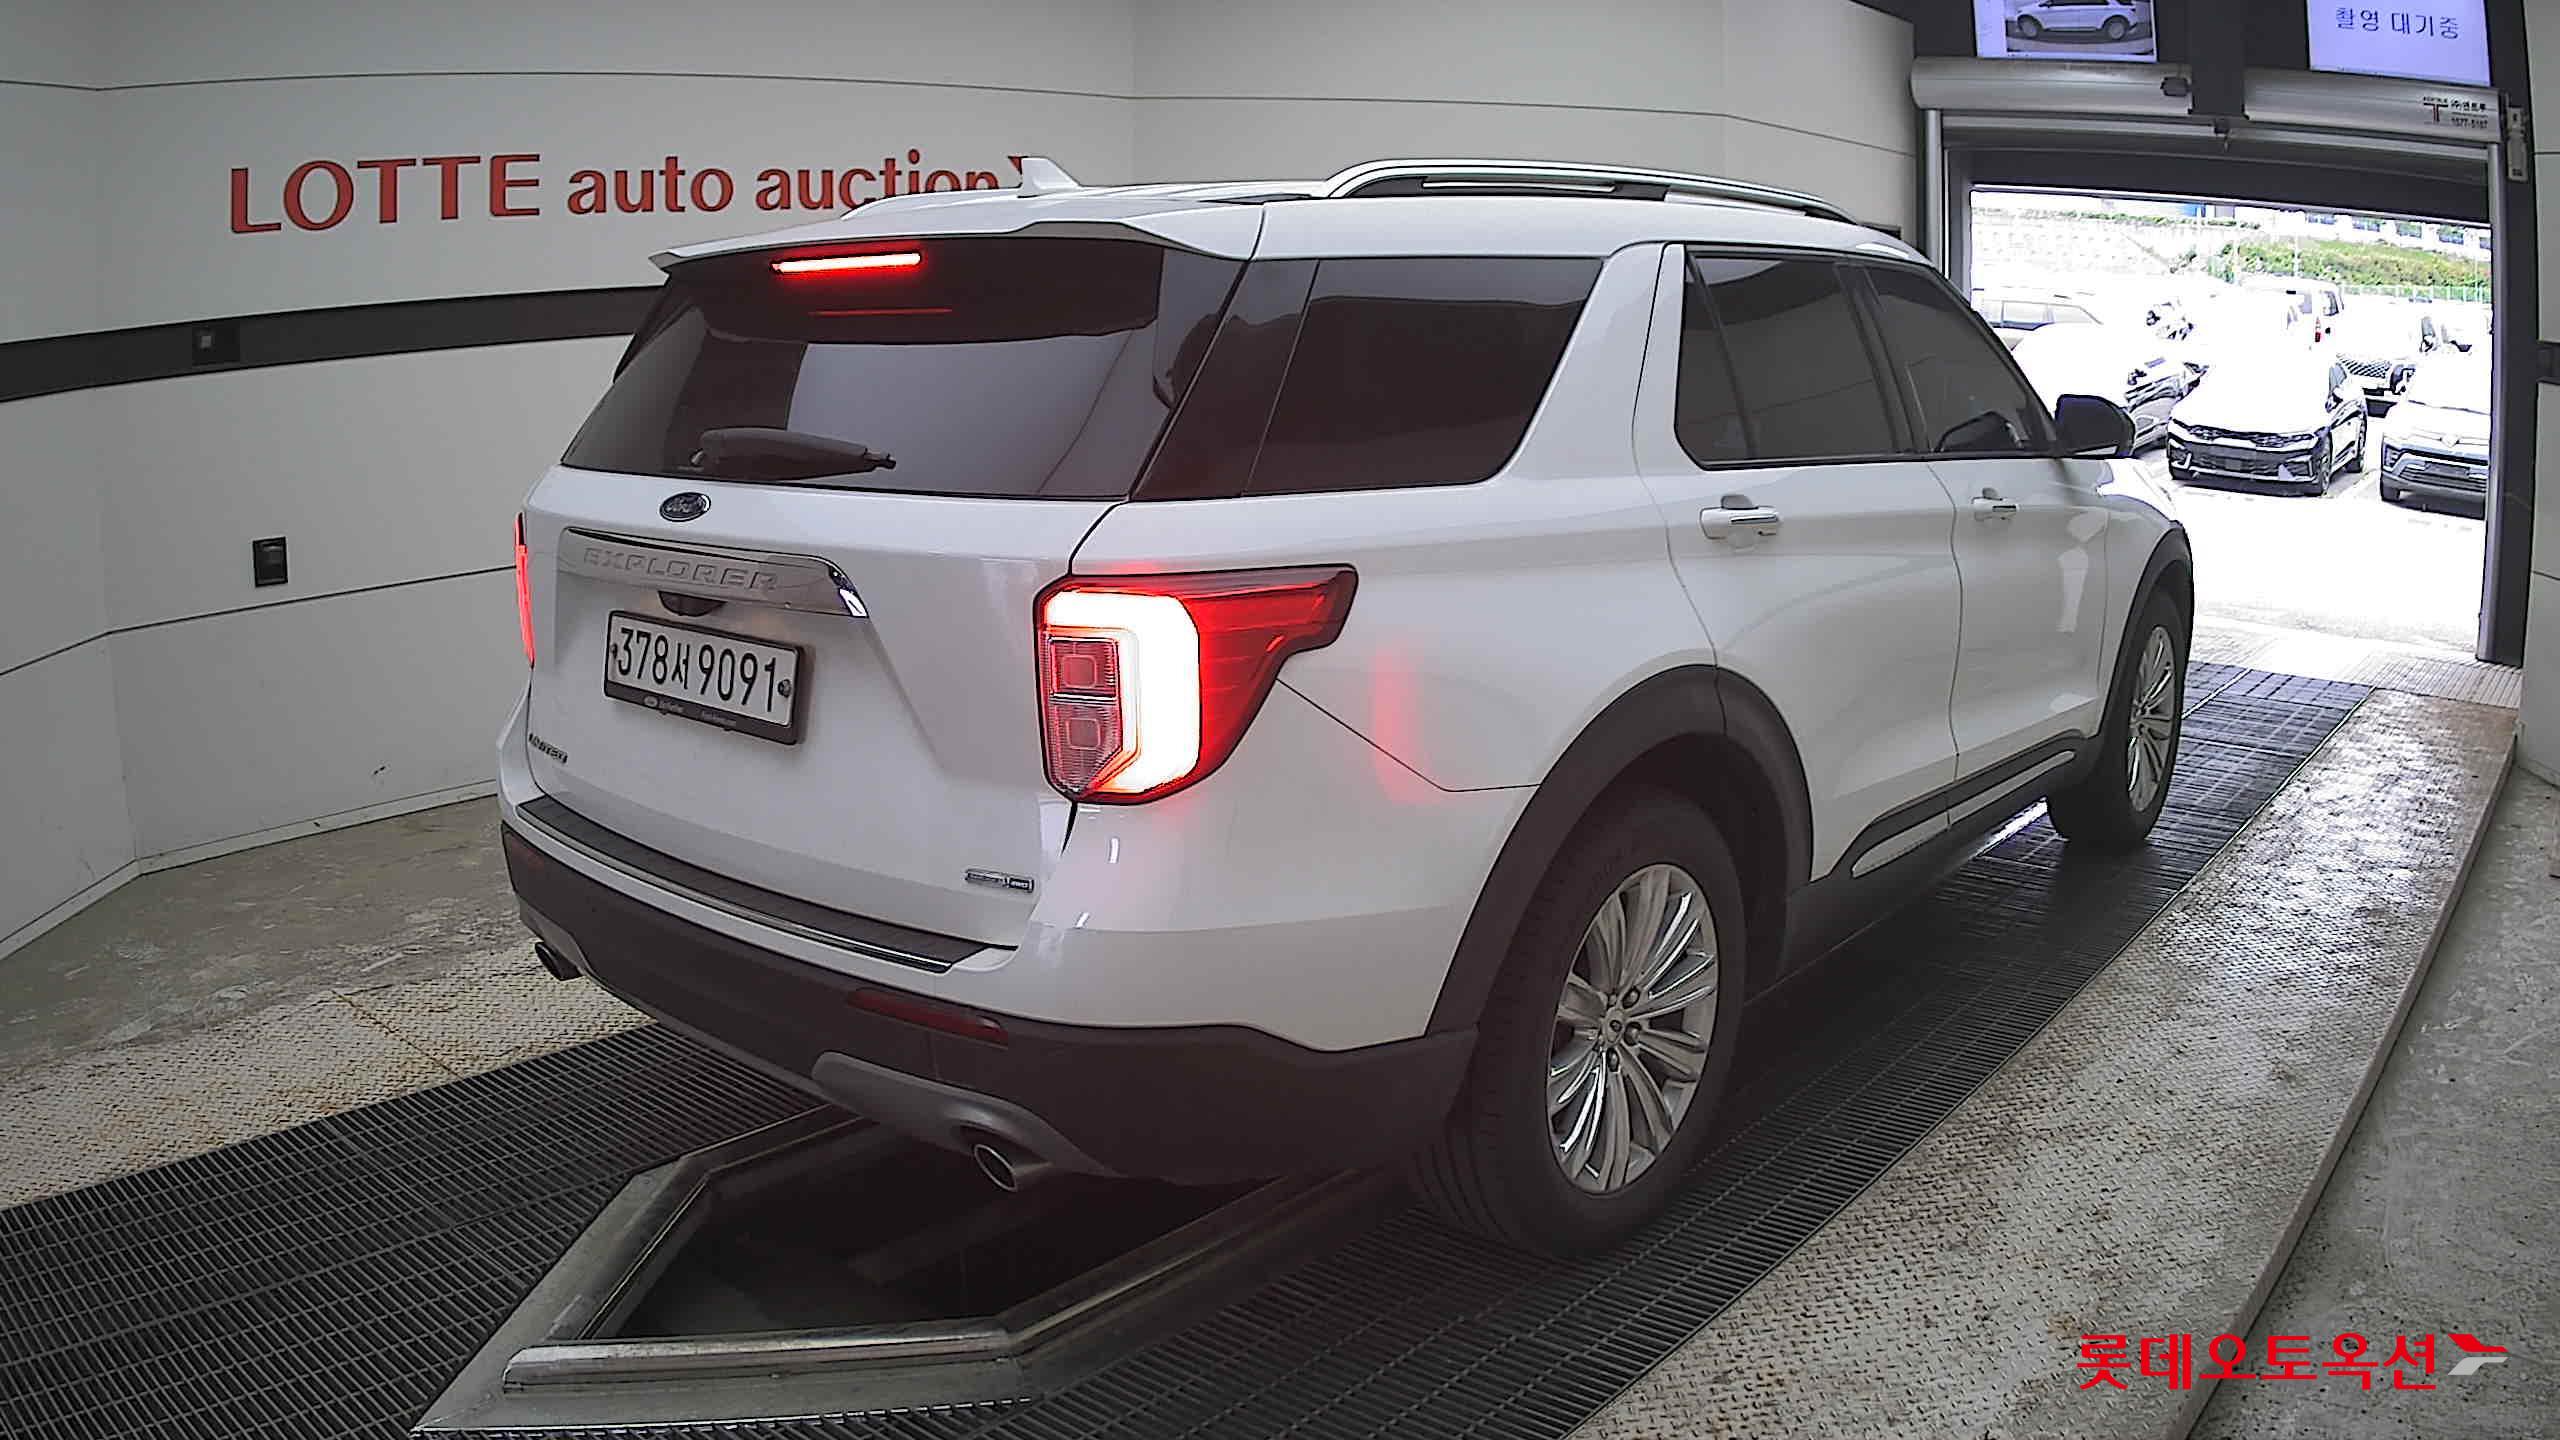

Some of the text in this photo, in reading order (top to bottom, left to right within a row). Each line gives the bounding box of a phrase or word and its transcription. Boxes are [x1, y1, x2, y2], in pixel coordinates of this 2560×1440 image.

[2391, 12, 2459, 40] 대기중
[230, 153, 541, 234] LOTTE
[567, 155, 735, 215] auto
[584, 547, 780, 590] EXPLORER
